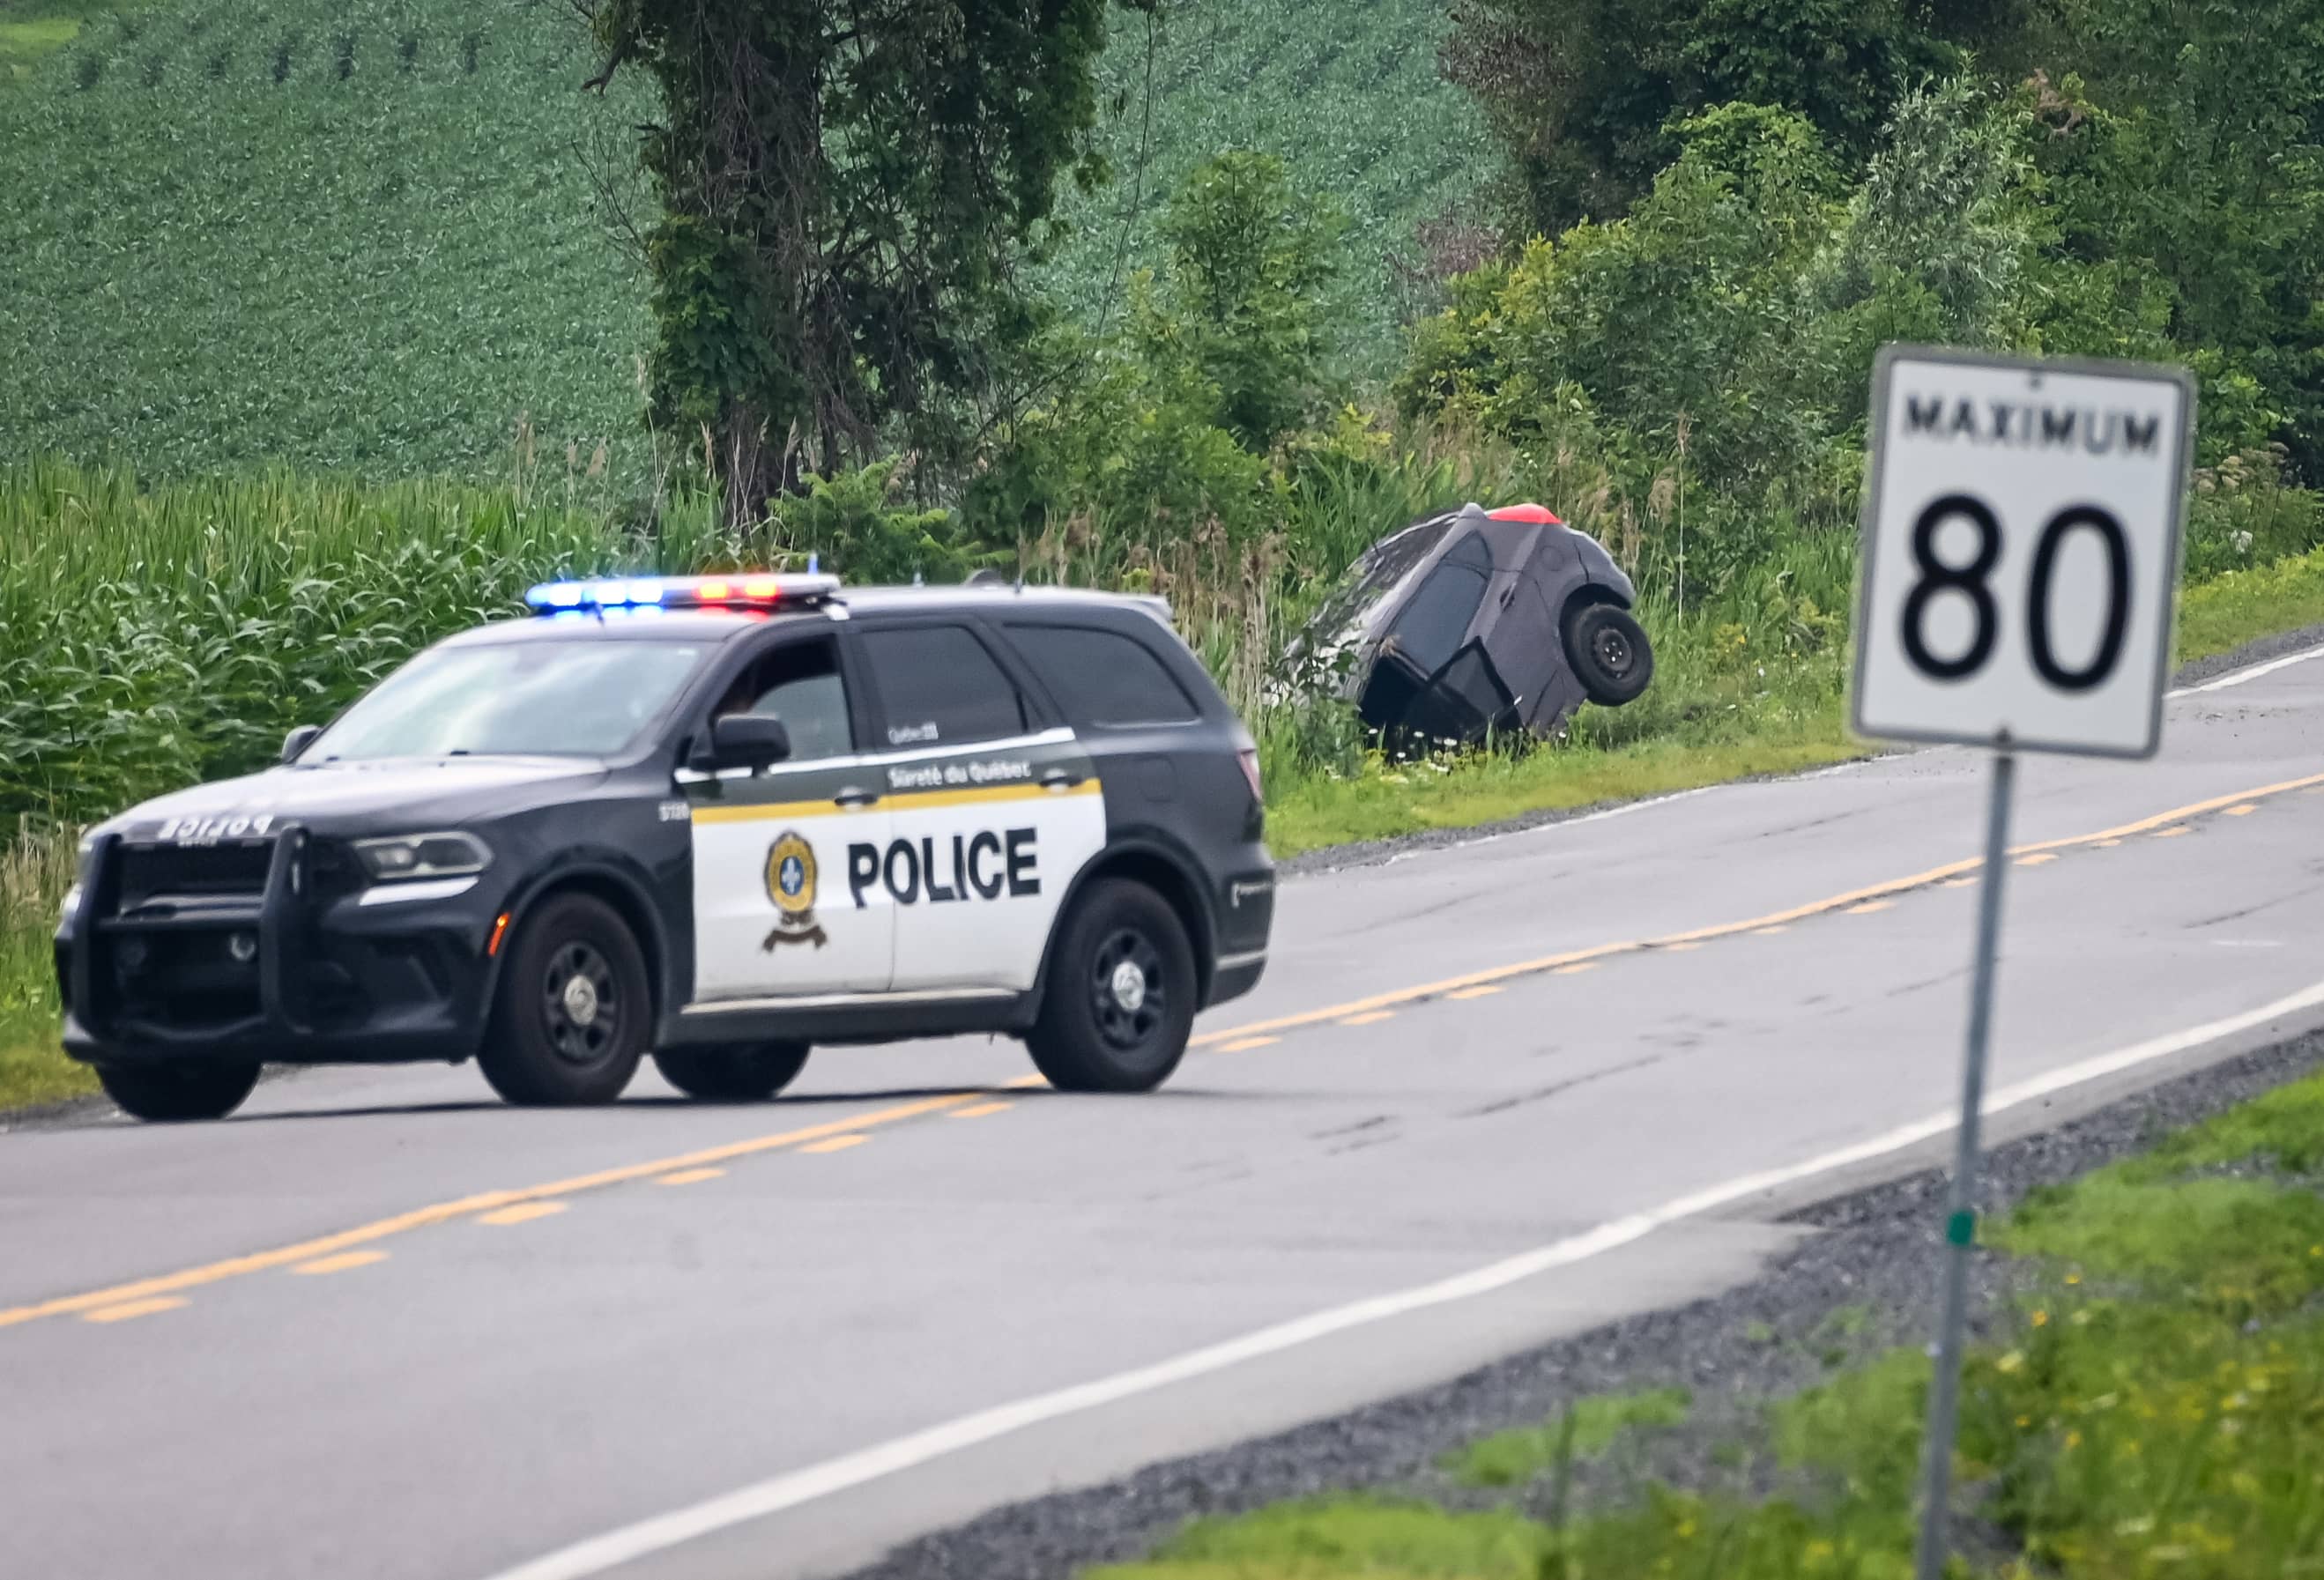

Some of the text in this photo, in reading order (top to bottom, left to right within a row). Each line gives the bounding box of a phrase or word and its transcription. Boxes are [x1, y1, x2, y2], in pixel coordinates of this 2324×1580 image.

[1904, 394, 2160, 456] MAXIMUM
[1901, 493, 2131, 694] 80
[944, 764, 969, 783] du
[848, 827, 1041, 909] POLICE
